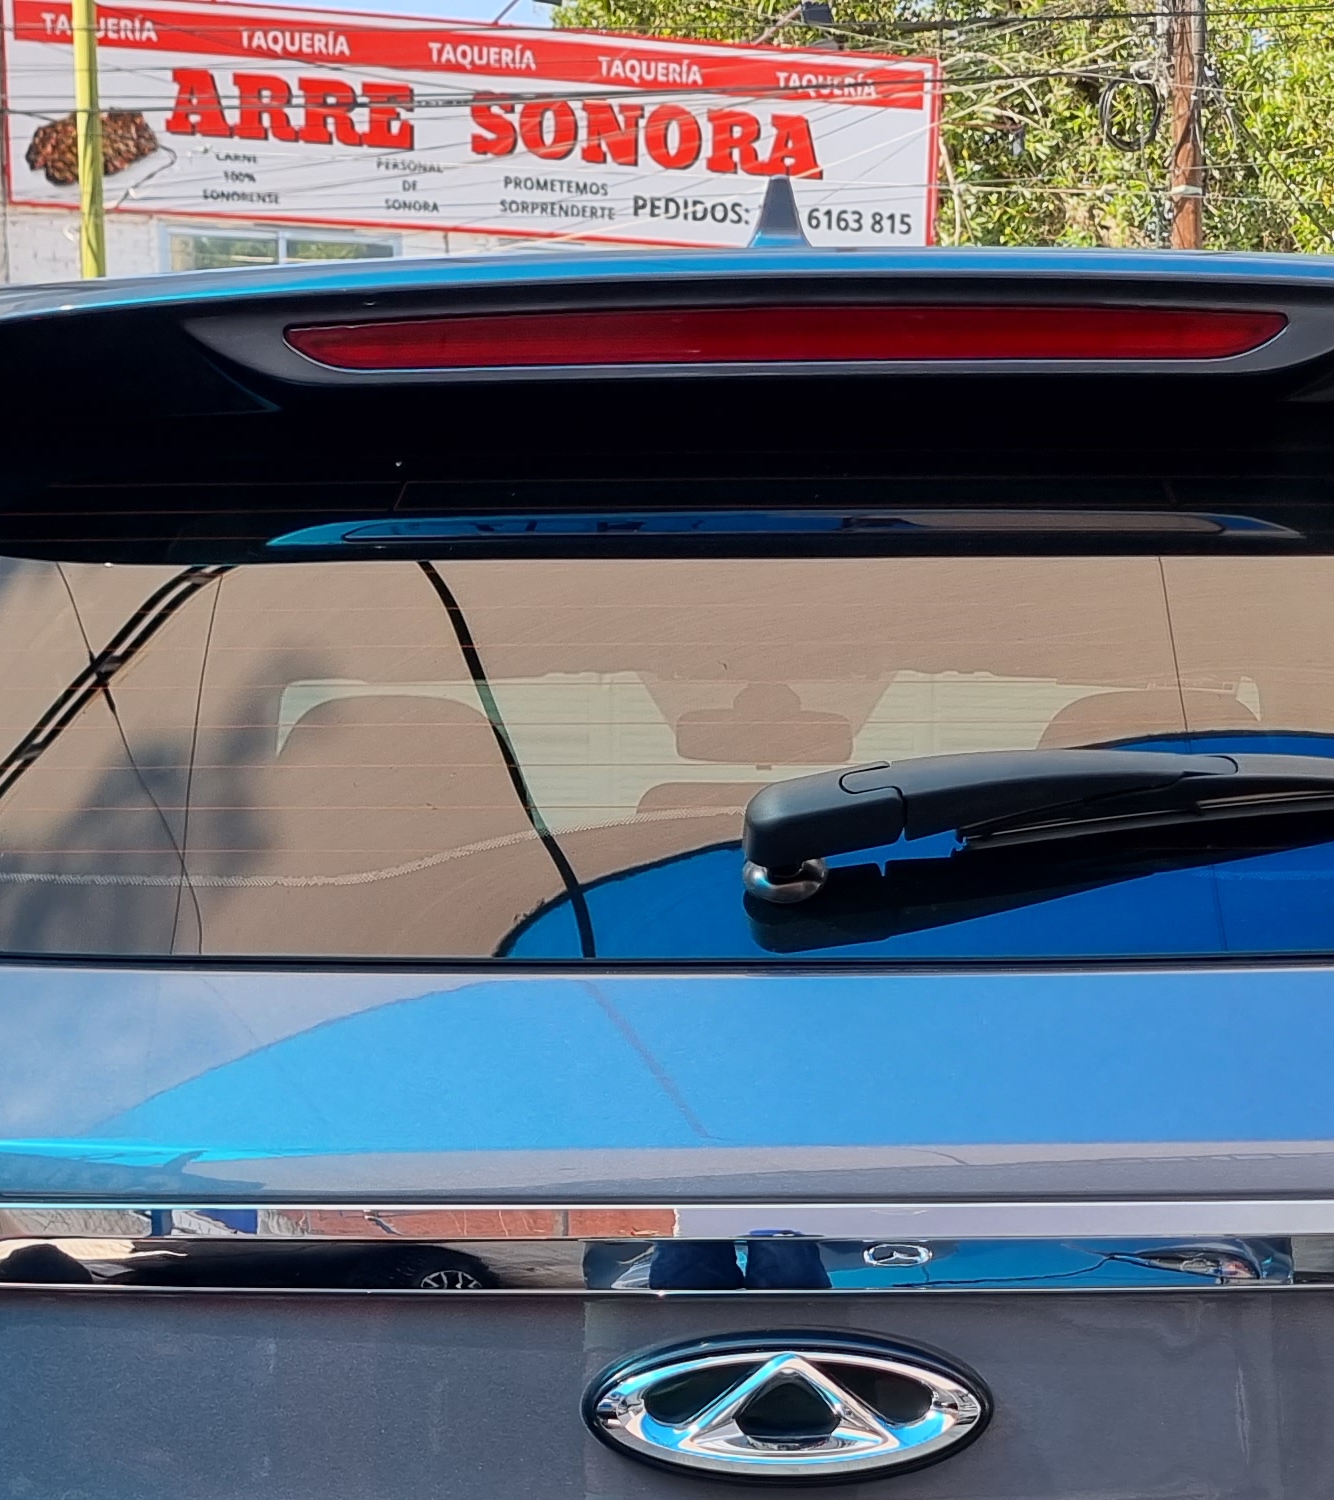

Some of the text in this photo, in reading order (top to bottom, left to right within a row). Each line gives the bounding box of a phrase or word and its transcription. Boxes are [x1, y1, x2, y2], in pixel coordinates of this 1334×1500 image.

[41, 12, 877, 98] TAUERÍA TAQUERÍA TAQUERÍA TAQUERÍA TAQUERÍA
[167, 68, 824, 180] ARRE SONORA
[503, 175, 609, 196] PROMETEMOS
[384, 198, 441, 213] SONORA
[499, 198, 616, 221] SORPRENDERTE
[632, 195, 912, 236] PEDIDOS: 6163 815
